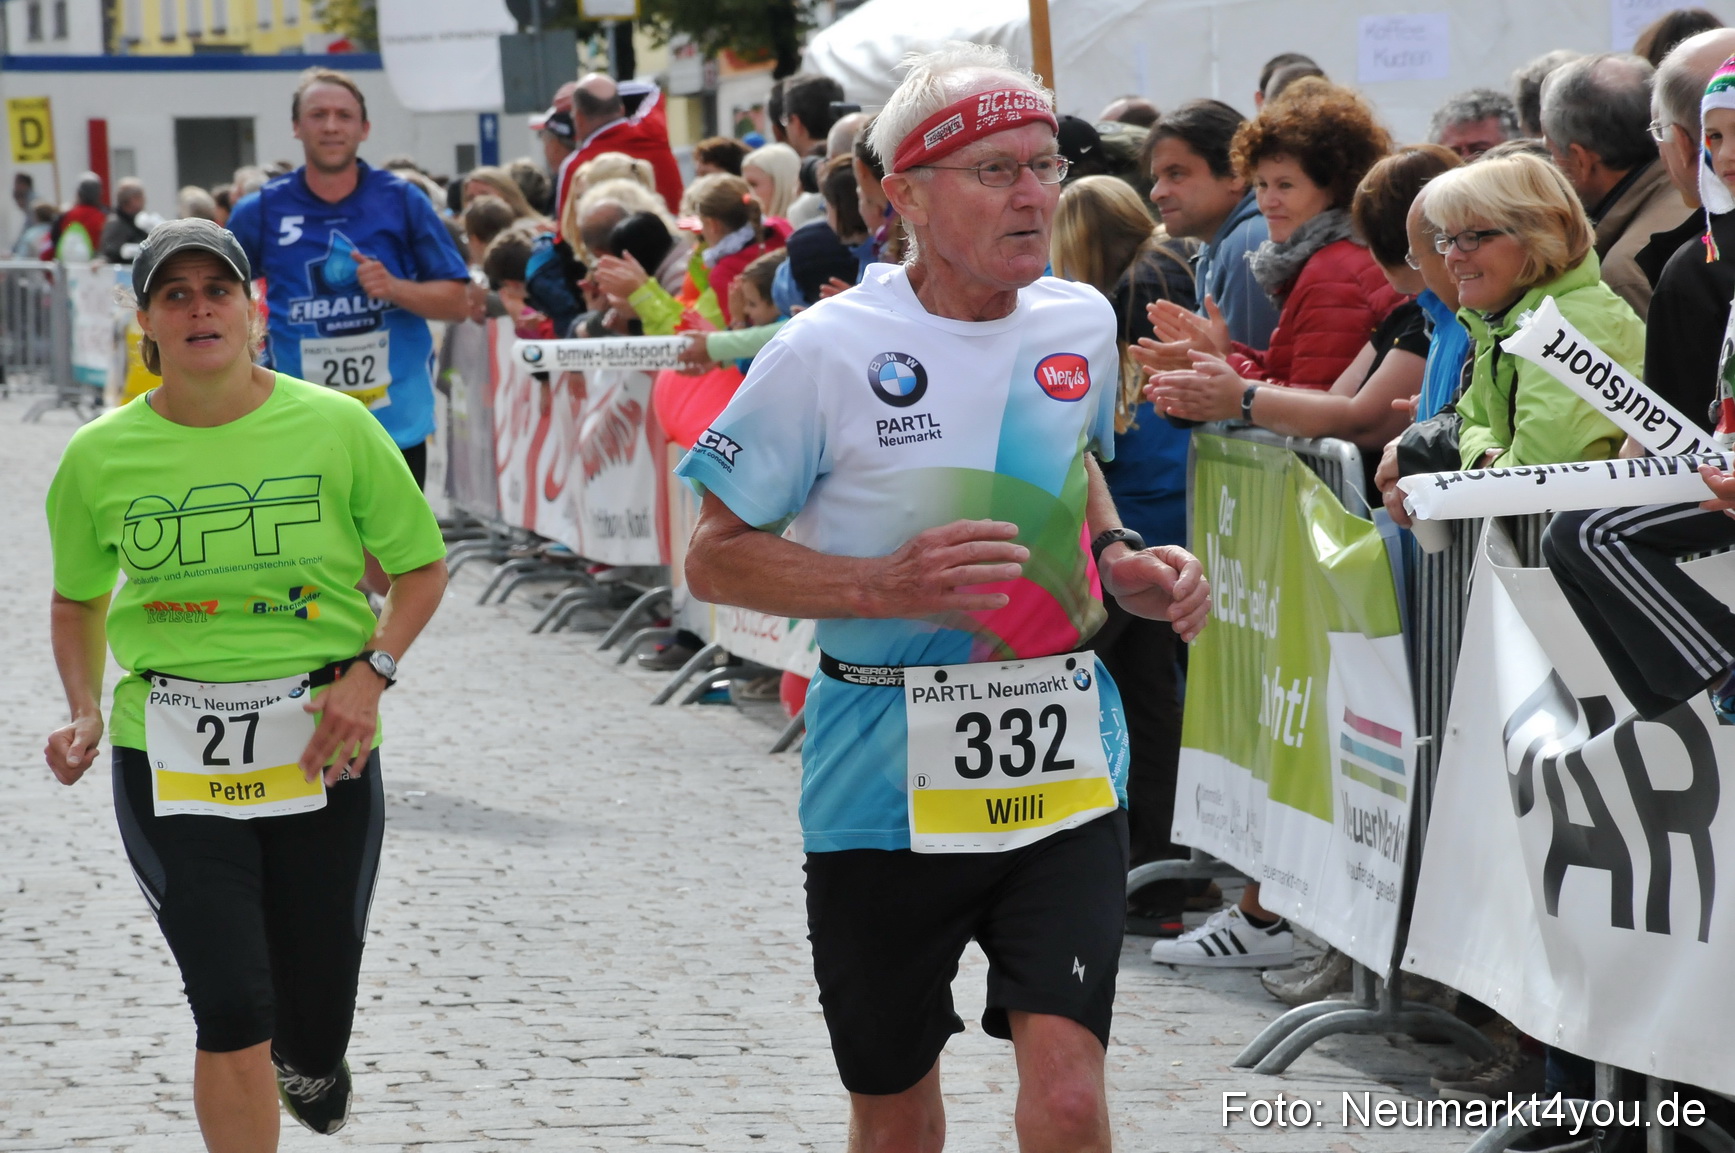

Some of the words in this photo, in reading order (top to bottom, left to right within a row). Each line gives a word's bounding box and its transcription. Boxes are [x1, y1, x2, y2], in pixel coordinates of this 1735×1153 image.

[19, 117, 43, 148] D
[278, 216, 304, 246] 5
[291, 295, 393, 321] FIBALO
[326, 318, 375, 331] BASKETS
[556, 340, 687, 361] bmw-laufsport.d
[871, 353, 918, 372] BMW
[323, 355, 376, 387] 262
[1042, 366, 1085, 389] Hervis
[1541, 328, 1683, 451] Laufsport
[876, 413, 940, 435] PARTL
[878, 429, 942, 447] Neumarkt
[707, 452, 732, 473] concepts
[1218, 484, 1236, 537] Der
[164, 570, 181, 582] und
[183, 559, 297, 578] Automatisierungstechnik
[298, 556, 323, 567] GmbH
[1206, 532, 1246, 628] Neue
[839, 663, 897, 675] SYNERGY
[860, 676, 905, 685] SPORT
[150, 692, 201, 709] PARTL
[205, 695, 281, 711] Neumarkt
[911, 684, 982, 703] PARTL
[988, 677, 1069, 698] Neumarkt
[196, 712, 259, 766] 27
[954, 703, 1075, 779] 332
[1111, 747, 1126, 777] September
[209, 781, 266, 801] Petra
[986, 794, 1044, 824] Willi
